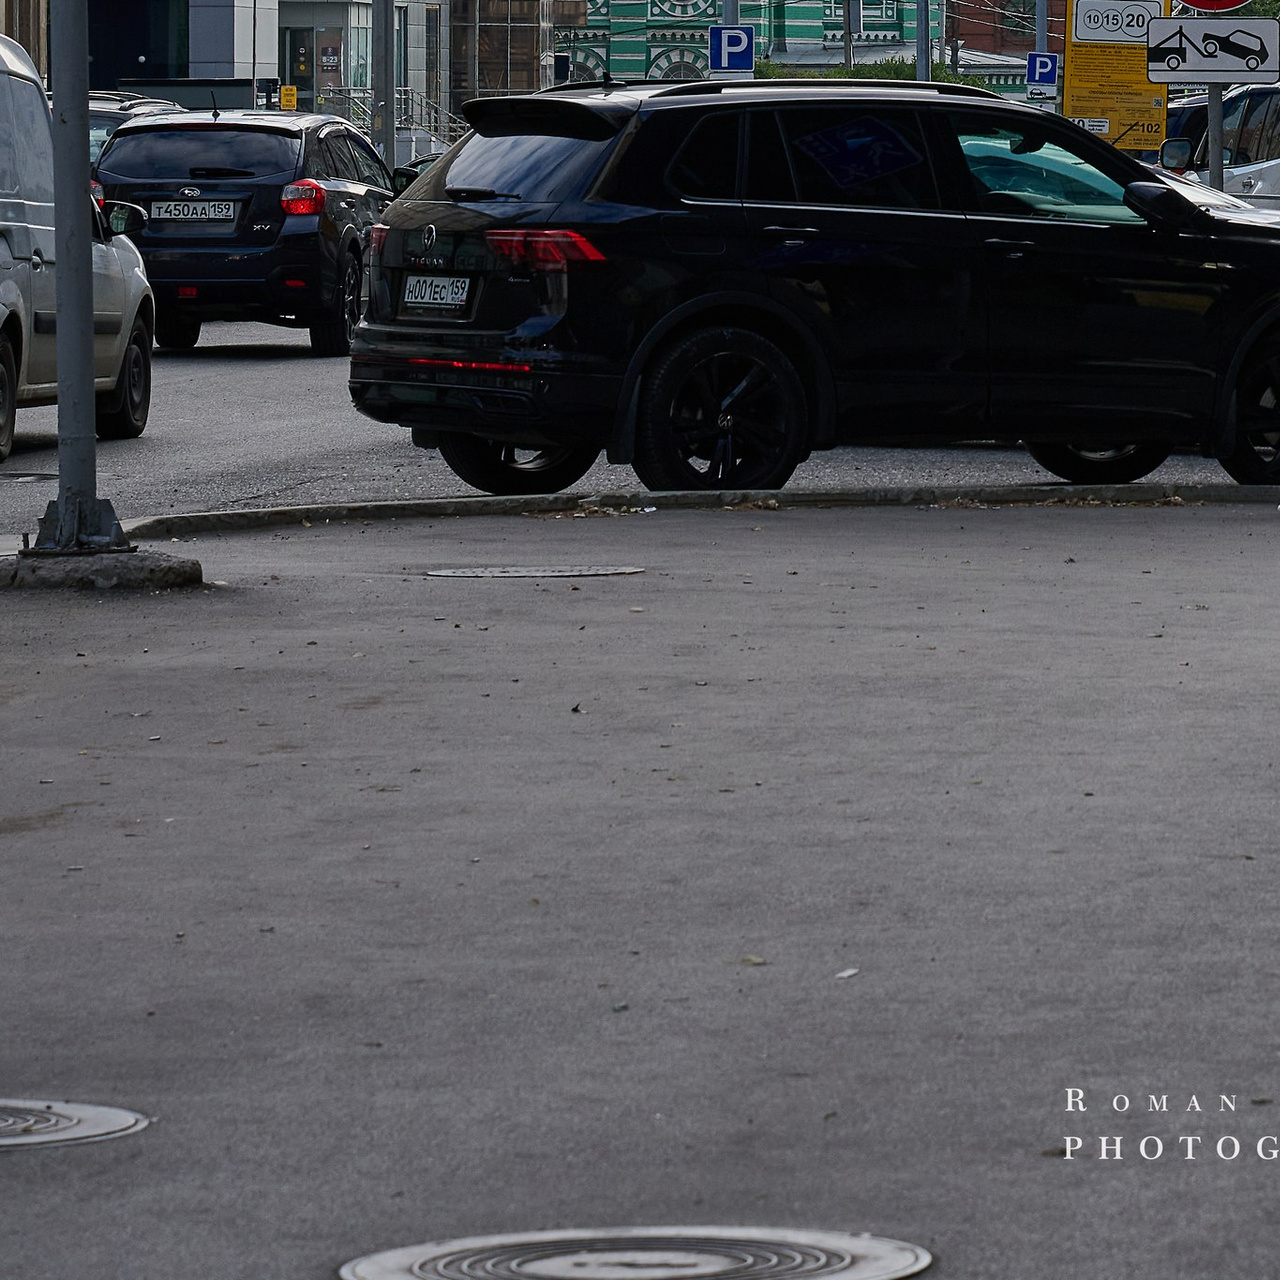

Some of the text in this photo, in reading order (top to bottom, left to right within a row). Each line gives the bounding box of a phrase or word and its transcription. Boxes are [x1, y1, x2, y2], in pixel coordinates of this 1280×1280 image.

[1086, 13, 1146, 28] 10 15 20
[1140, 123, 1160, 133] 102
[156, 203, 230, 218] Т450АА 159
[450, 279, 467, 296] 159
